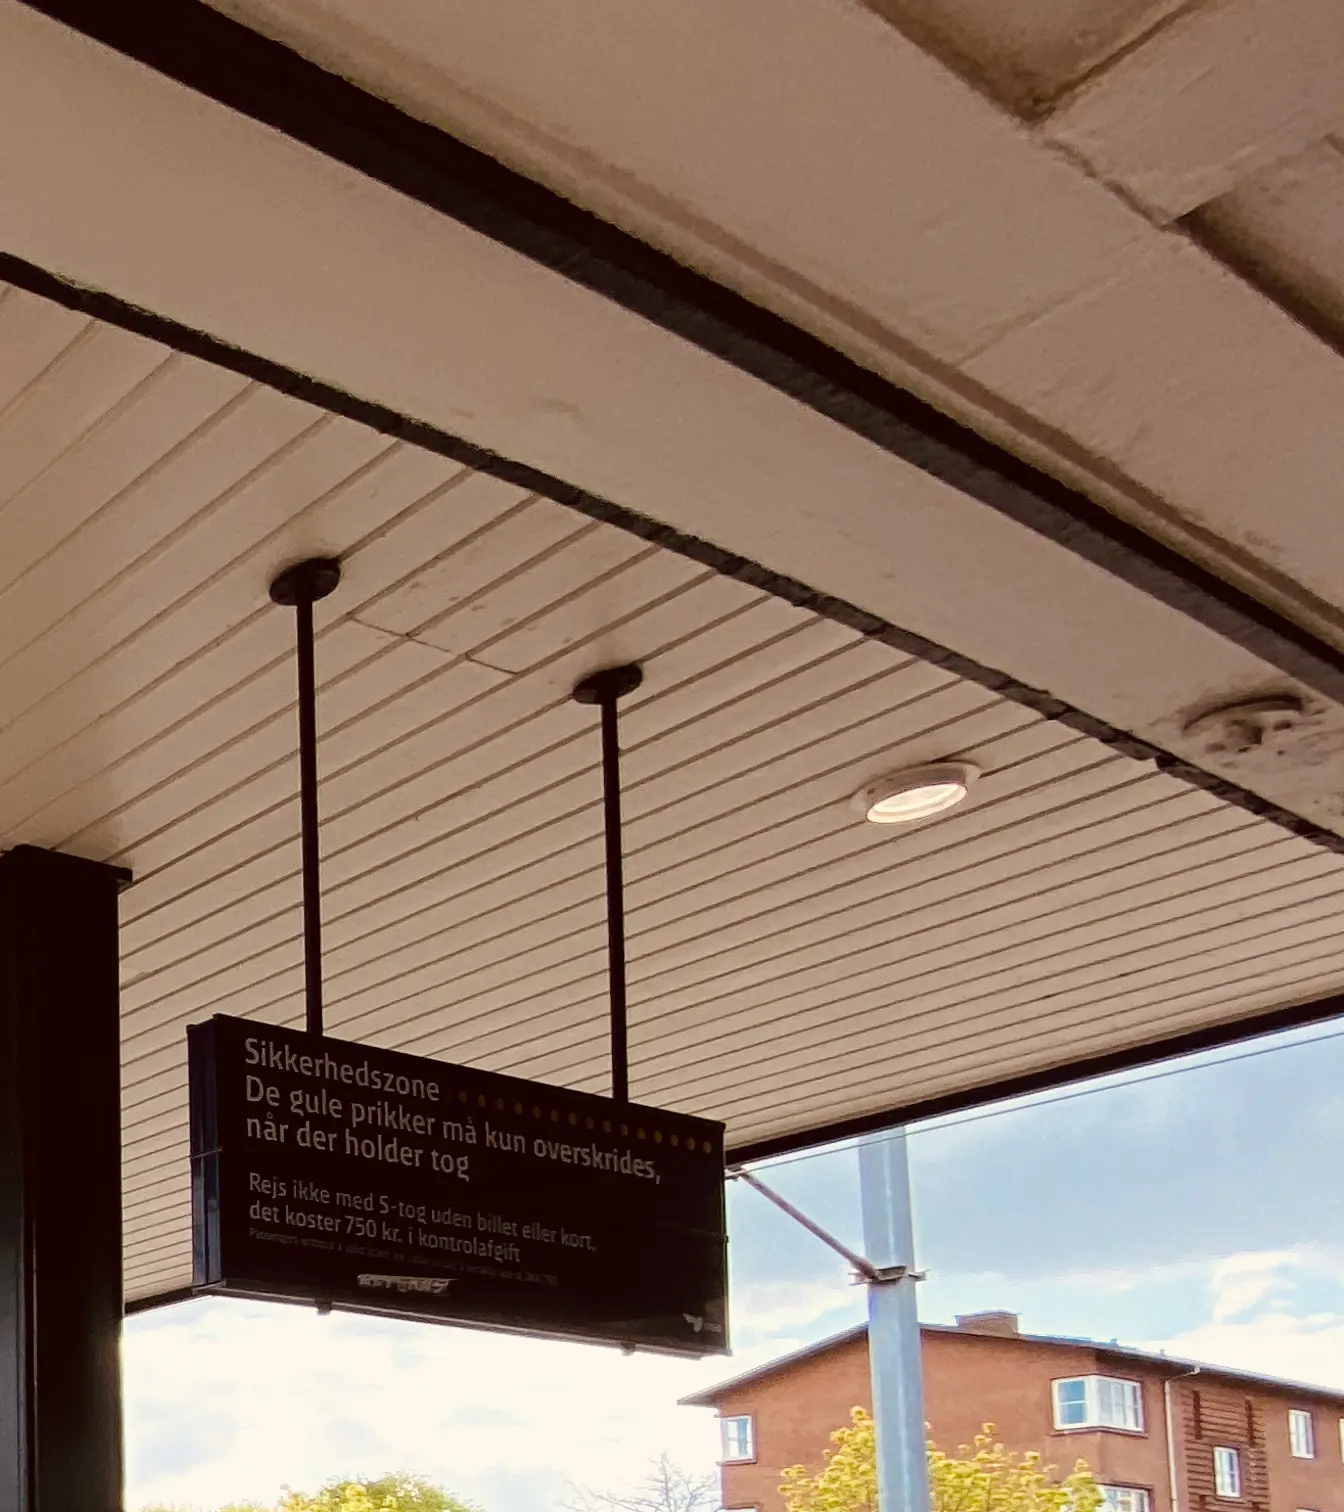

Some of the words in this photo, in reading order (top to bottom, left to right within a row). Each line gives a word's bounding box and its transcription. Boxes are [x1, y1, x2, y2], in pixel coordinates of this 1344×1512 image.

[245, 1037, 440, 1101] Sikkerhedszone
[246, 1075, 280, 1106] De
[289, 1088, 343, 1118] gule
[351, 1101, 436, 1135] prikker
[443, 1115, 477, 1144] må
[485, 1121, 526, 1153] kun
[533, 1143, 661, 1185] overskrides,
[247, 1111, 289, 1143] når
[296, 1120, 337, 1152] der
[345, 1128, 424, 1167] holder
[430, 1149, 470, 1183] tog
[249, 1172, 287, 1198] Rejs
[292, 1179, 331, 1204] ikke
[336, 1191, 374, 1211] med
[431, 1207, 472, 1228] uden
[477, 1211, 518, 1237] billet
[522, 1222, 558, 1243] eller
[249, 1200, 280, 1223] det
[285, 1204, 342, 1233] koster
[345, 1215, 377, 1238] 750
[382, 1221, 403, 1243] kr.
[408, 1226, 413, 1244] i
[418, 1227, 521, 1263] kontrolafgift
